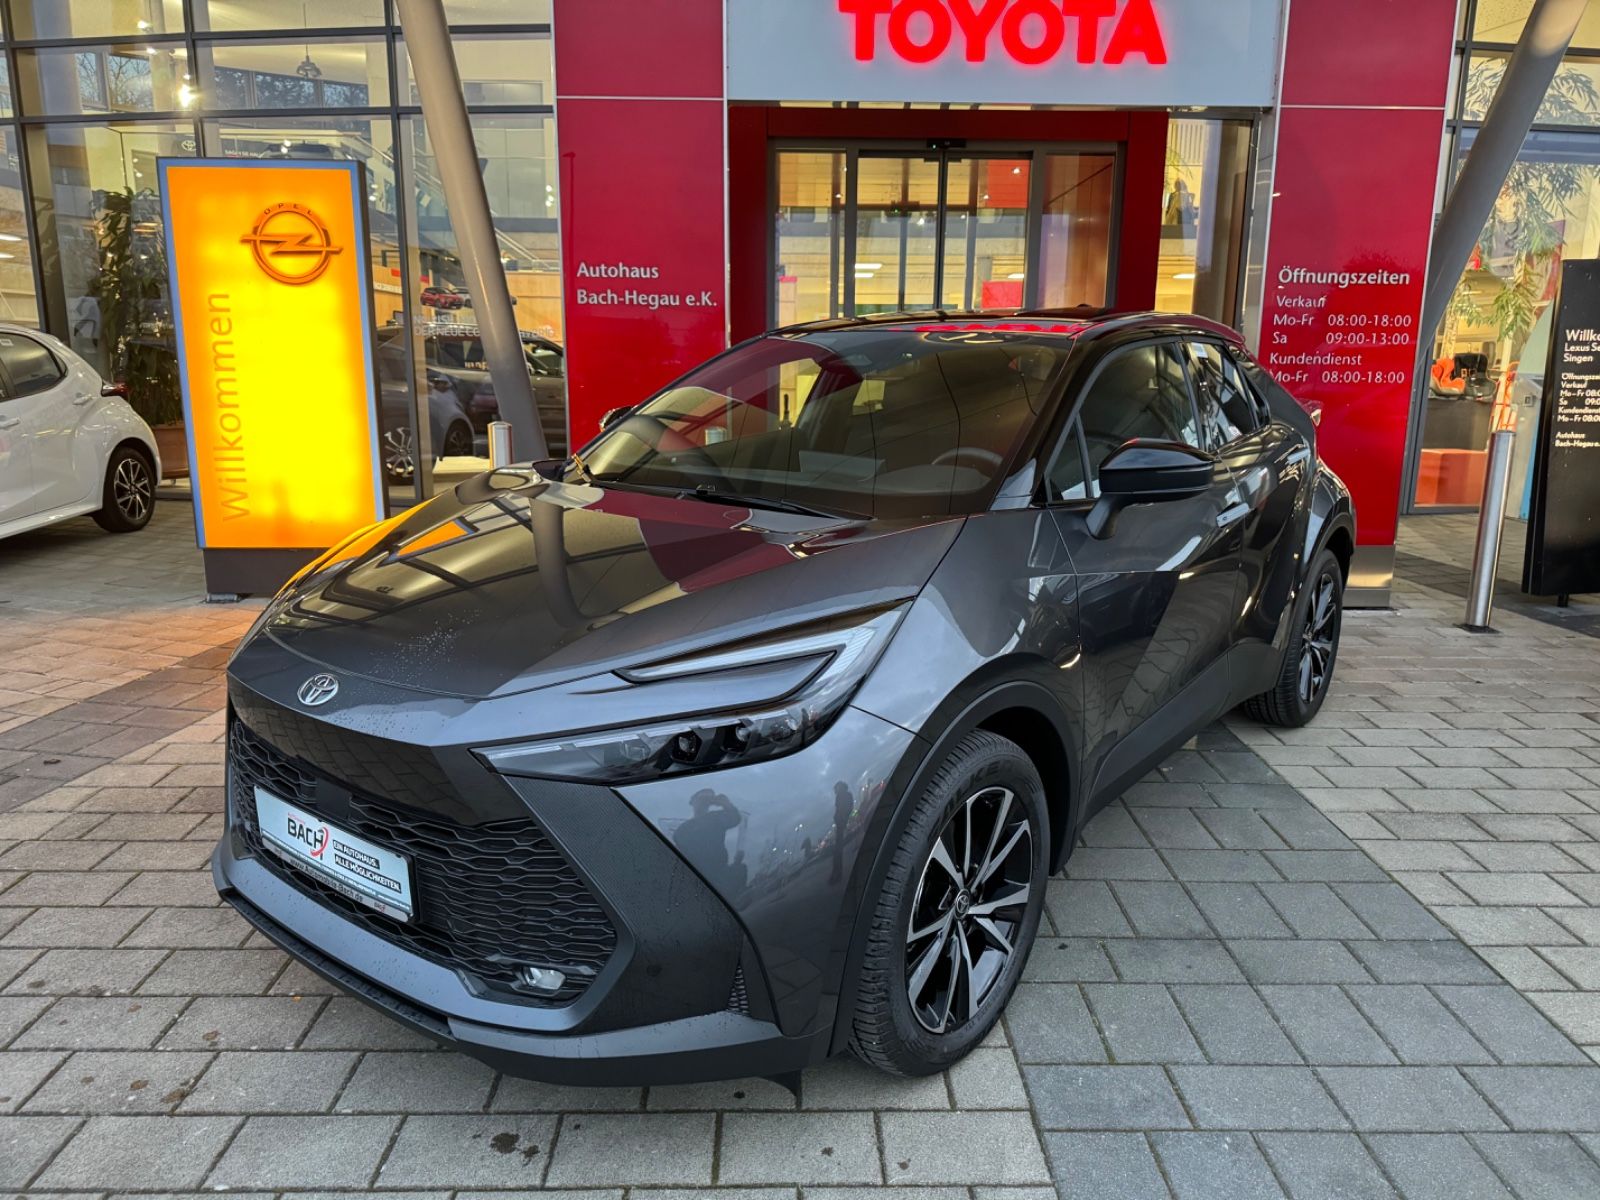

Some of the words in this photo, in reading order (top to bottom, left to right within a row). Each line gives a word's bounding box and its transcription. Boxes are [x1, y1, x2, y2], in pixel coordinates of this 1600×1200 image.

[838, 0, 1167, 65] TOYOTA
[263, 202, 313, 216] OPEL
[576, 262, 659, 278] Autohaus
[1278, 265, 1410, 288] Öffnungszeiten
[576, 289, 680, 310] Bach-Hegau
[685, 291, 718, 306] e.K.
[1276, 295, 1326, 308] Verkauf
[1273, 314, 1314, 326] Mo-Fr
[1328, 314, 1412, 327] 08:00-18:00
[1272, 332, 1288, 344] Sa
[1326, 332, 1410, 345] 09:00-13:00
[1564, 342, 1590, 352] Lexus
[1269, 352, 1362, 365] Kundendienst
[1563, 353, 1593, 364] Singen
[1269, 371, 1309, 382] Mo-Fr
[1321, 371, 1405, 384] 08:00-18:00
[288, 817, 324, 853] BACH
